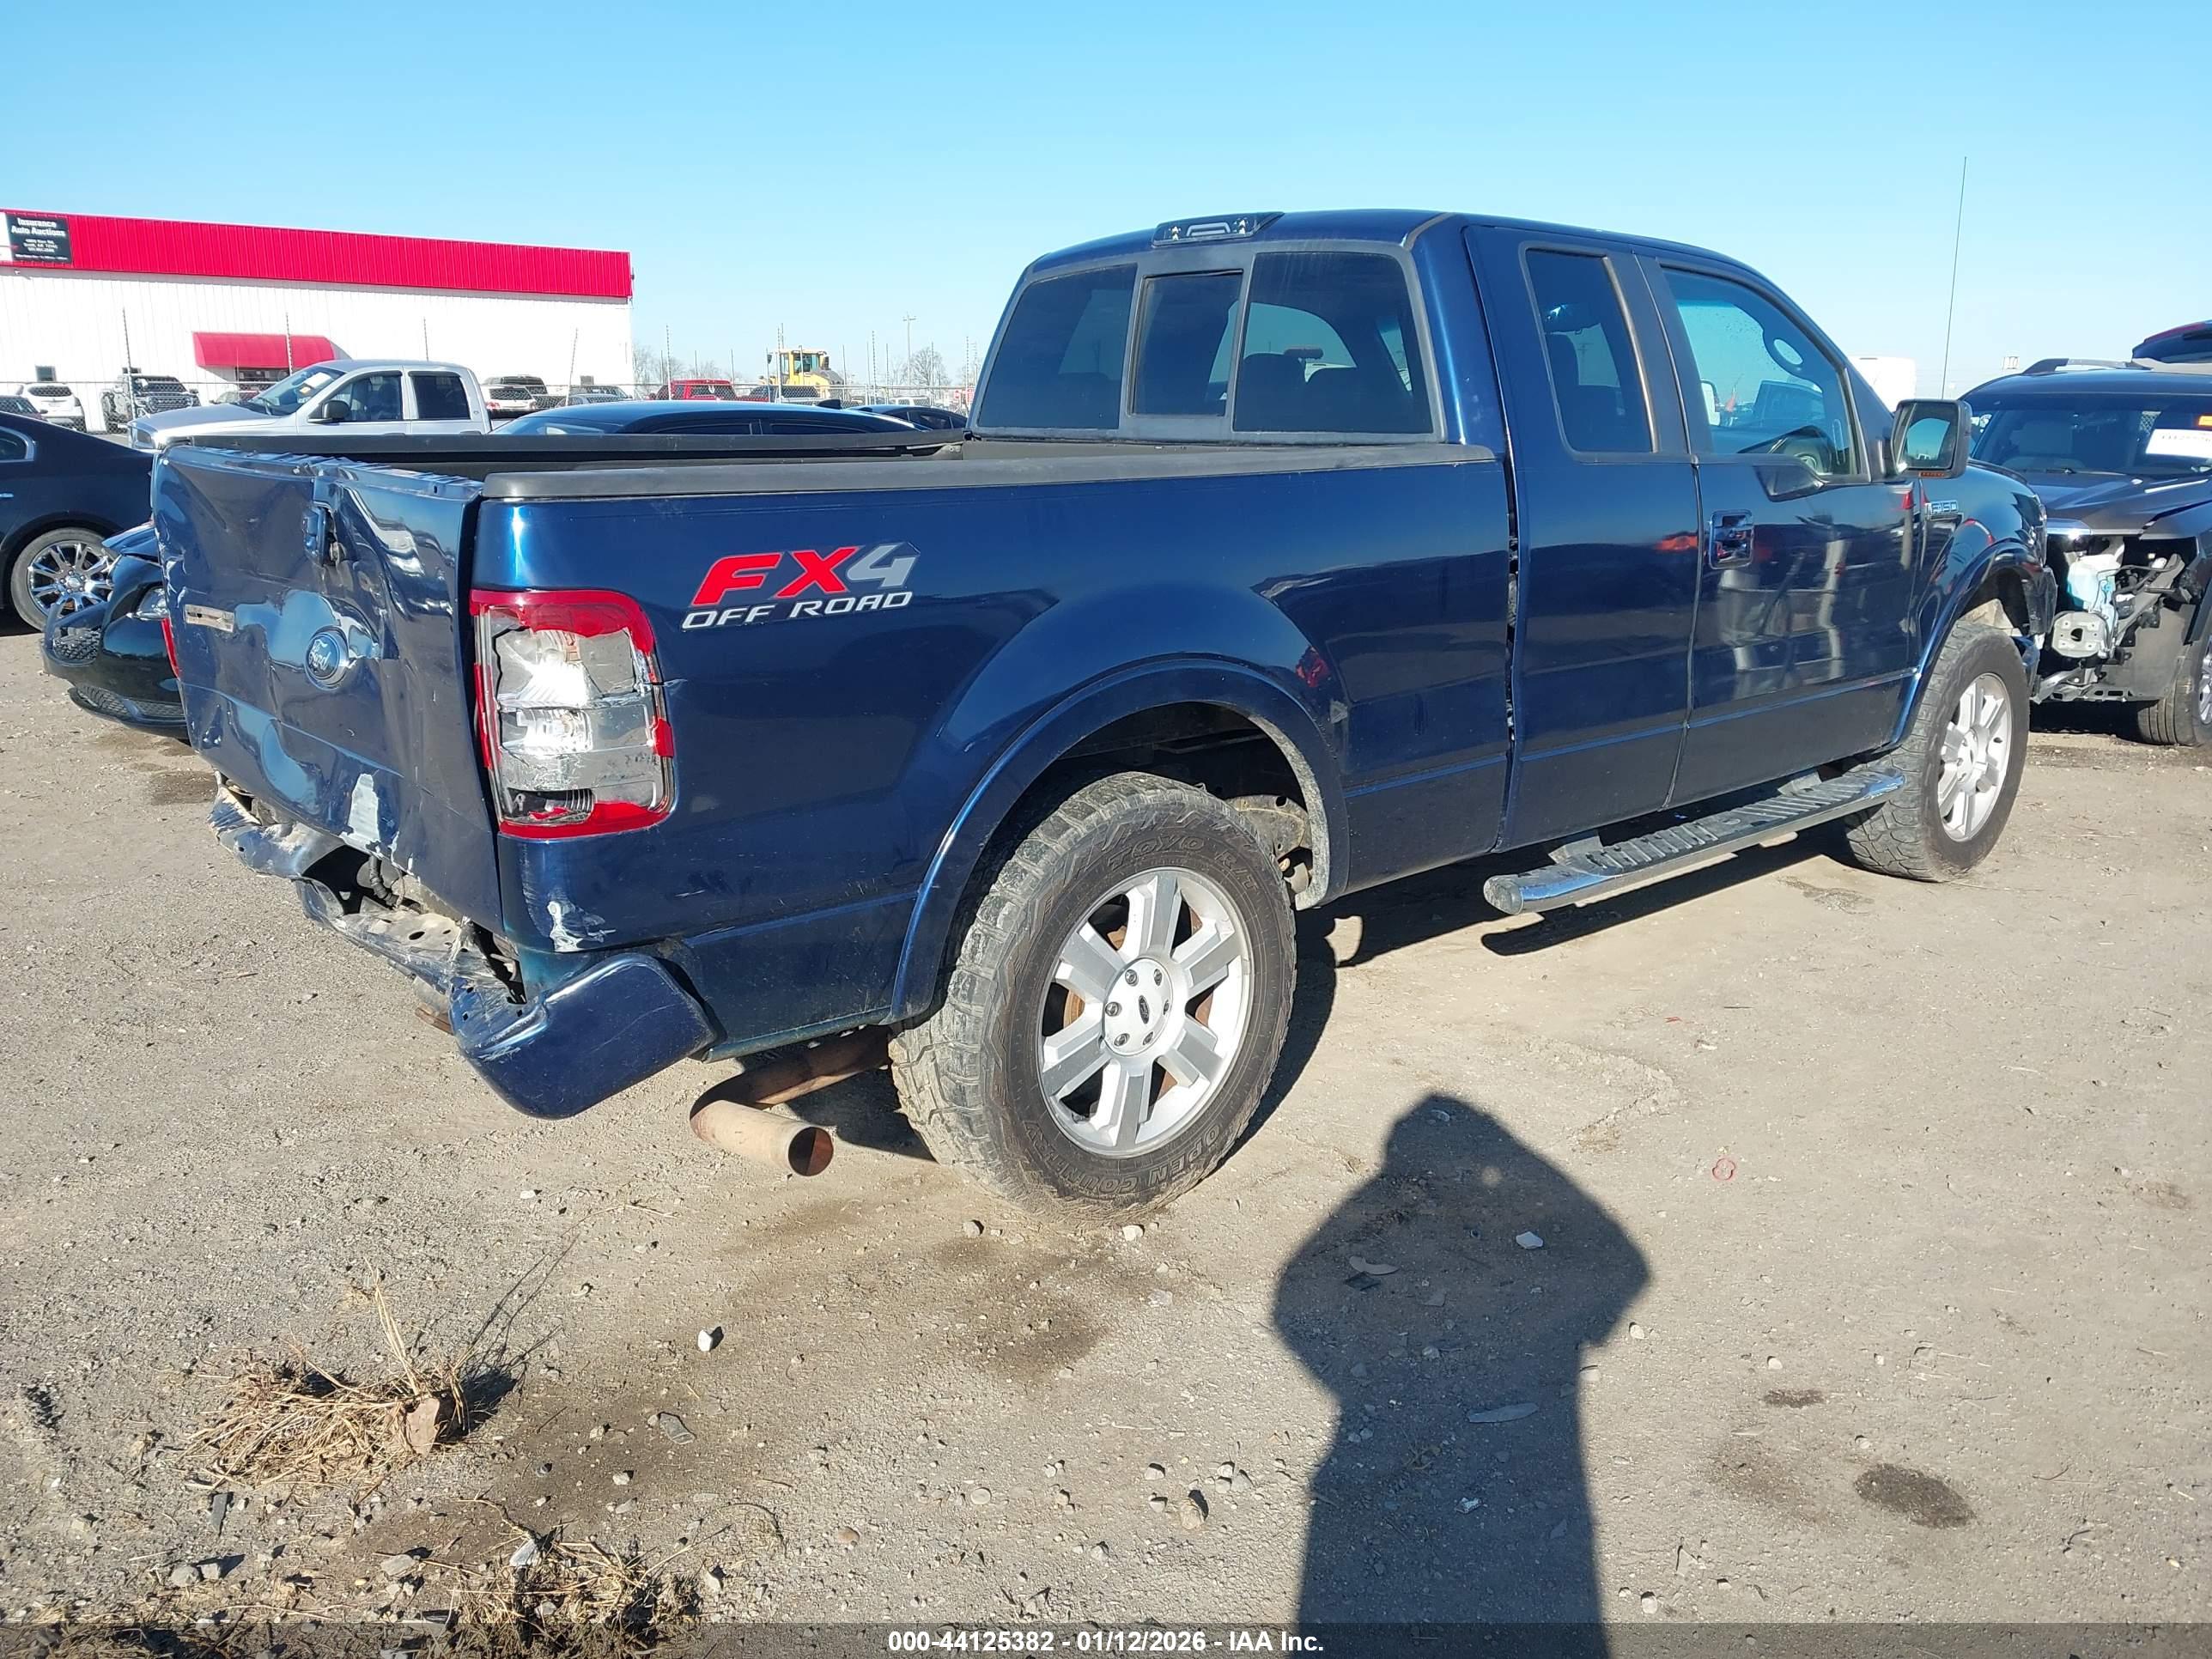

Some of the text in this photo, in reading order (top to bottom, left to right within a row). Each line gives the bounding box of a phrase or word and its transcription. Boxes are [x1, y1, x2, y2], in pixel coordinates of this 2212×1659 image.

[31, 228, 65, 237] Auctions
[690, 544, 918, 607] FX4
[682, 592, 913, 629] OFF ROAD
[308, 639, 331, 672] Ford
[1108, 835, 1205, 871] TOYO
[1023, 1120, 1220, 1194] OPEN COUNTRY
